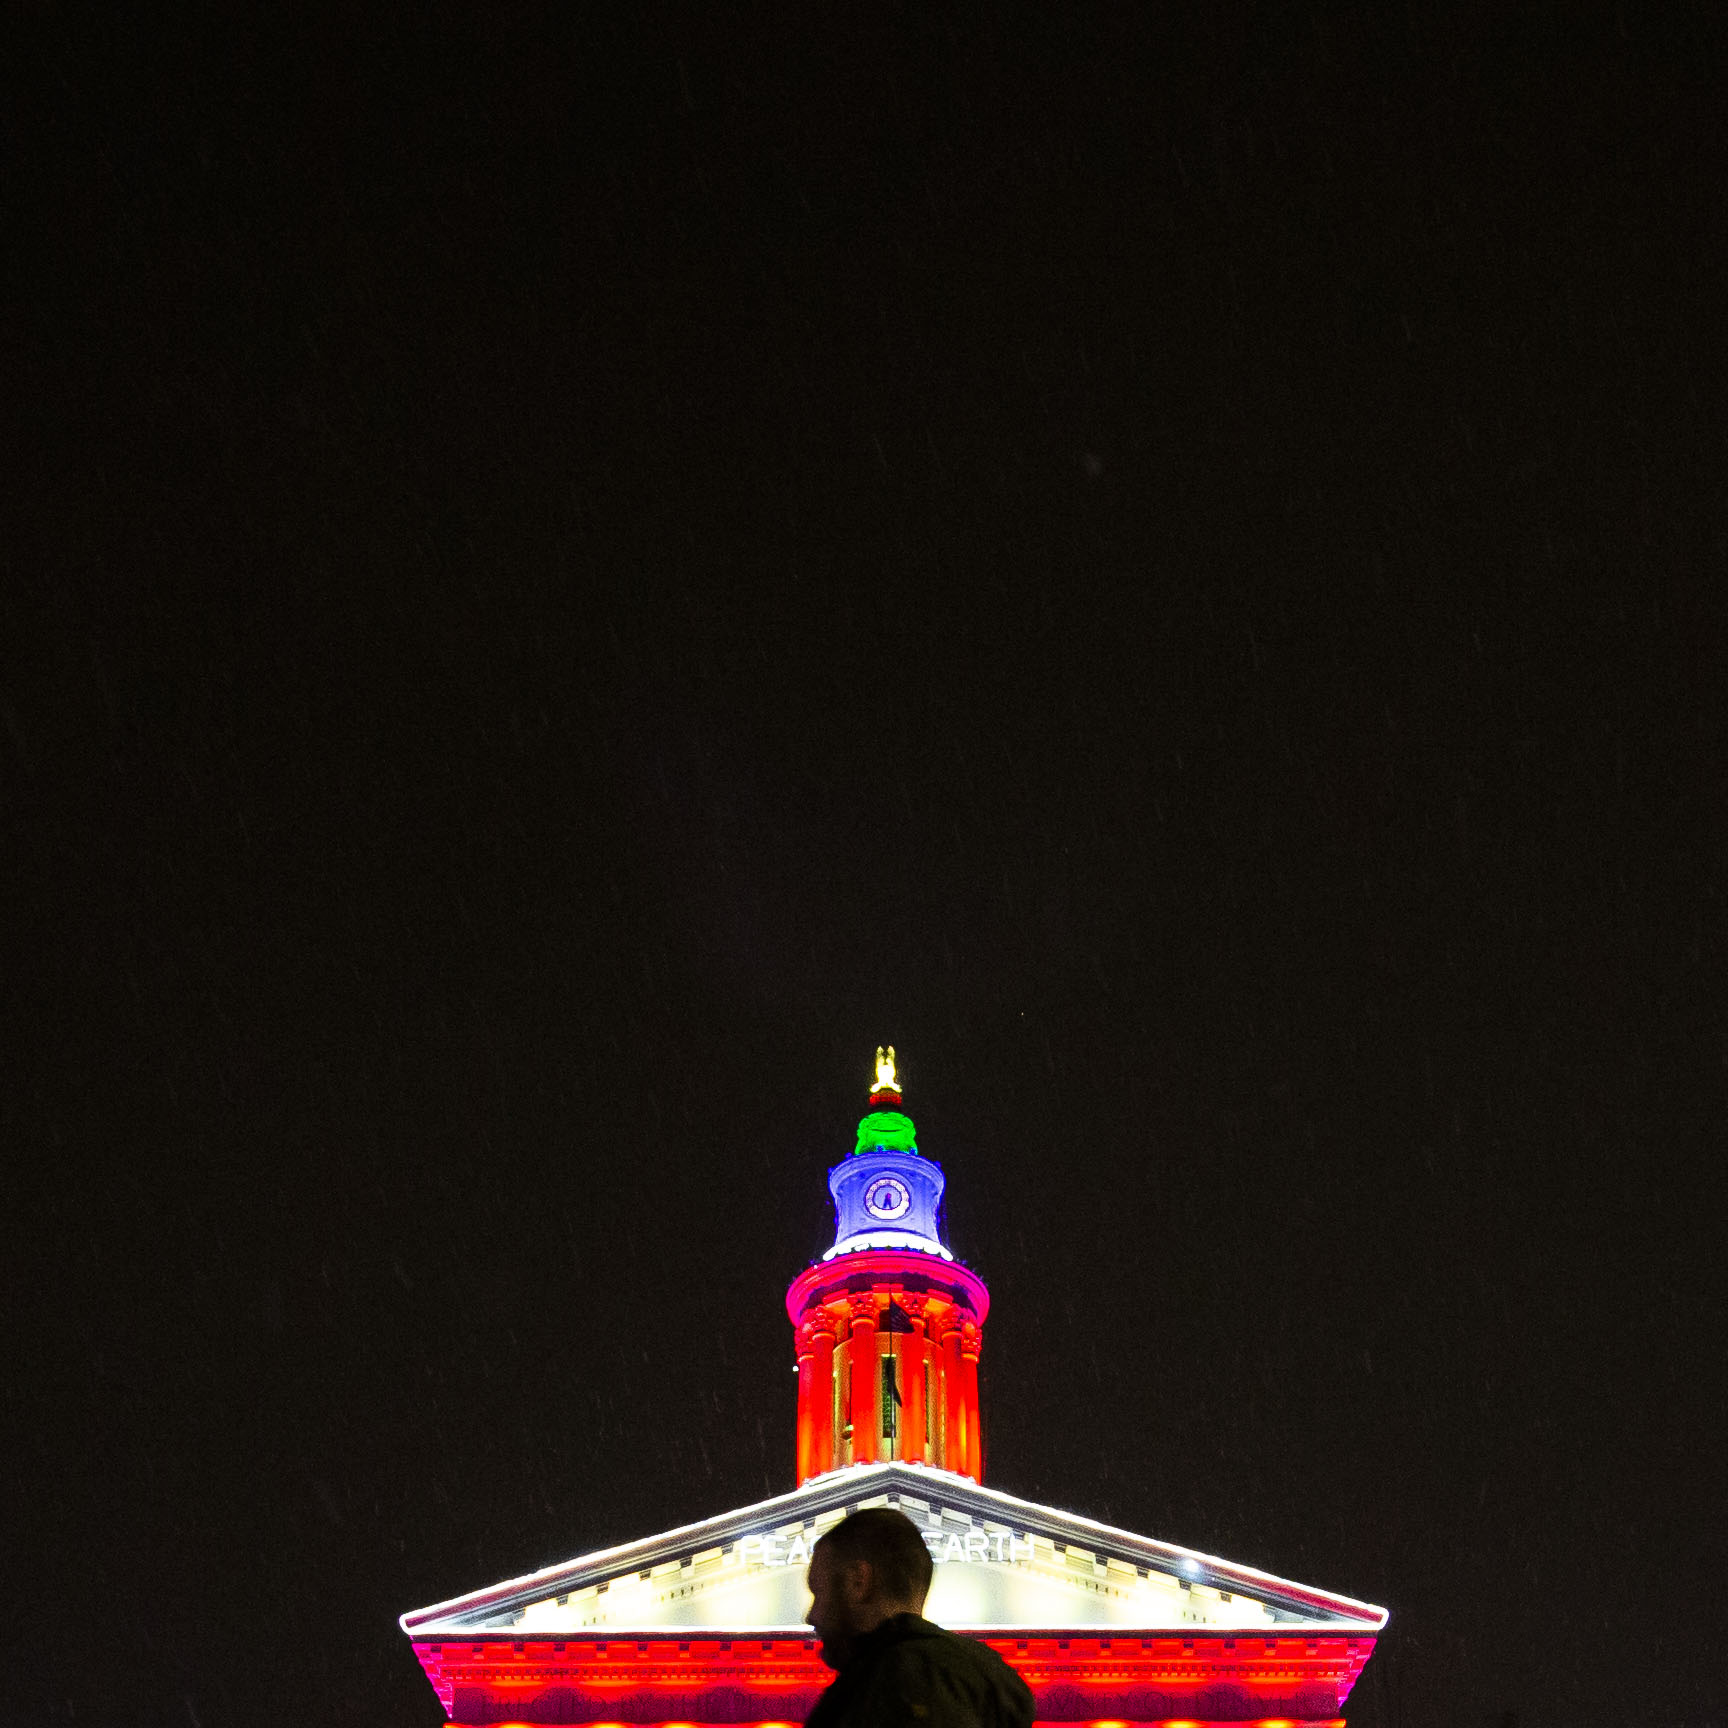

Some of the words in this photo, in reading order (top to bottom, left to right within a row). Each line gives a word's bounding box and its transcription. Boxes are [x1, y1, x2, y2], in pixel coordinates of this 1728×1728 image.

[740, 1535, 822, 1566] PEA
[920, 1531, 1035, 1563] EARTH
[480, 1693, 608, 1718] ERECTED
